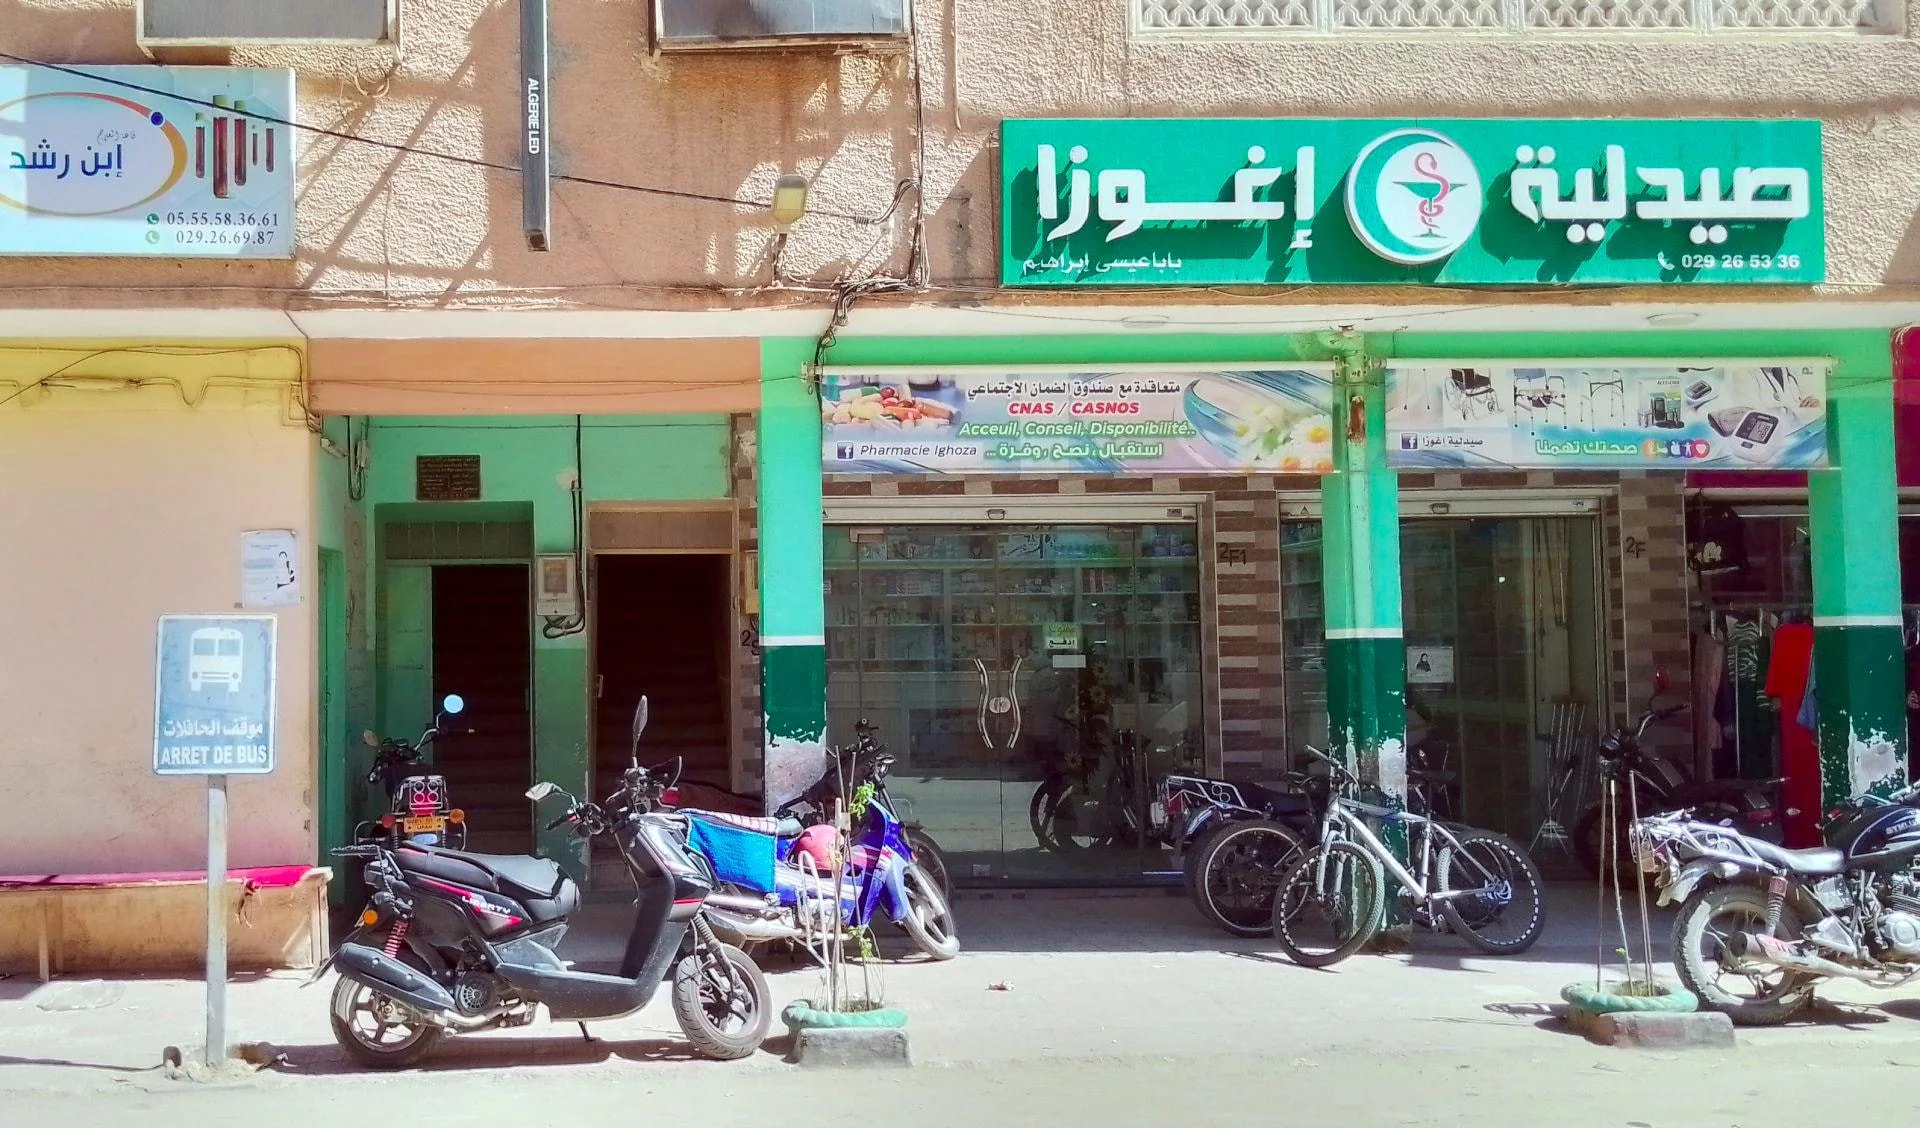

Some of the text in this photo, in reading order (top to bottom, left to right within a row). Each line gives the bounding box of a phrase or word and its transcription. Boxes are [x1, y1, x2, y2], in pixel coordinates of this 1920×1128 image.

[527, 77, 540, 154] ALGERIE LED
[9, 138, 122, 180] إبن رشد
[1036, 143, 1810, 249] صيدلية إغوزا
[167, 212, 279, 226] 05.55.58.36.61
[176, 230, 275, 245] 029.26.69.87
[1681, 254, 1800, 269] 029 26 53 36
[967, 380, 1181, 400] متعاقدة مع صندوق الضمان الاجتماعي
[1009, 402, 1053, 415] CNAS
[1071, 401, 1139, 414] CASNOS
[959, 422, 1020, 436] Acceuil,
[1025, 422, 1085, 436] Conseil,
[1448, 435, 1483, 448] صيدلية
[1535, 440, 1638, 456] صحتك تهمنا
[860, 445, 977, 457] Pharmacie Ighoza
[1220, 542, 1246, 566] 2F1
[1625, 536, 1646, 558] 2F
[163, 717, 263, 739] موقف الحافلات
[160, 744, 267, 765] ARRET DE BUS
